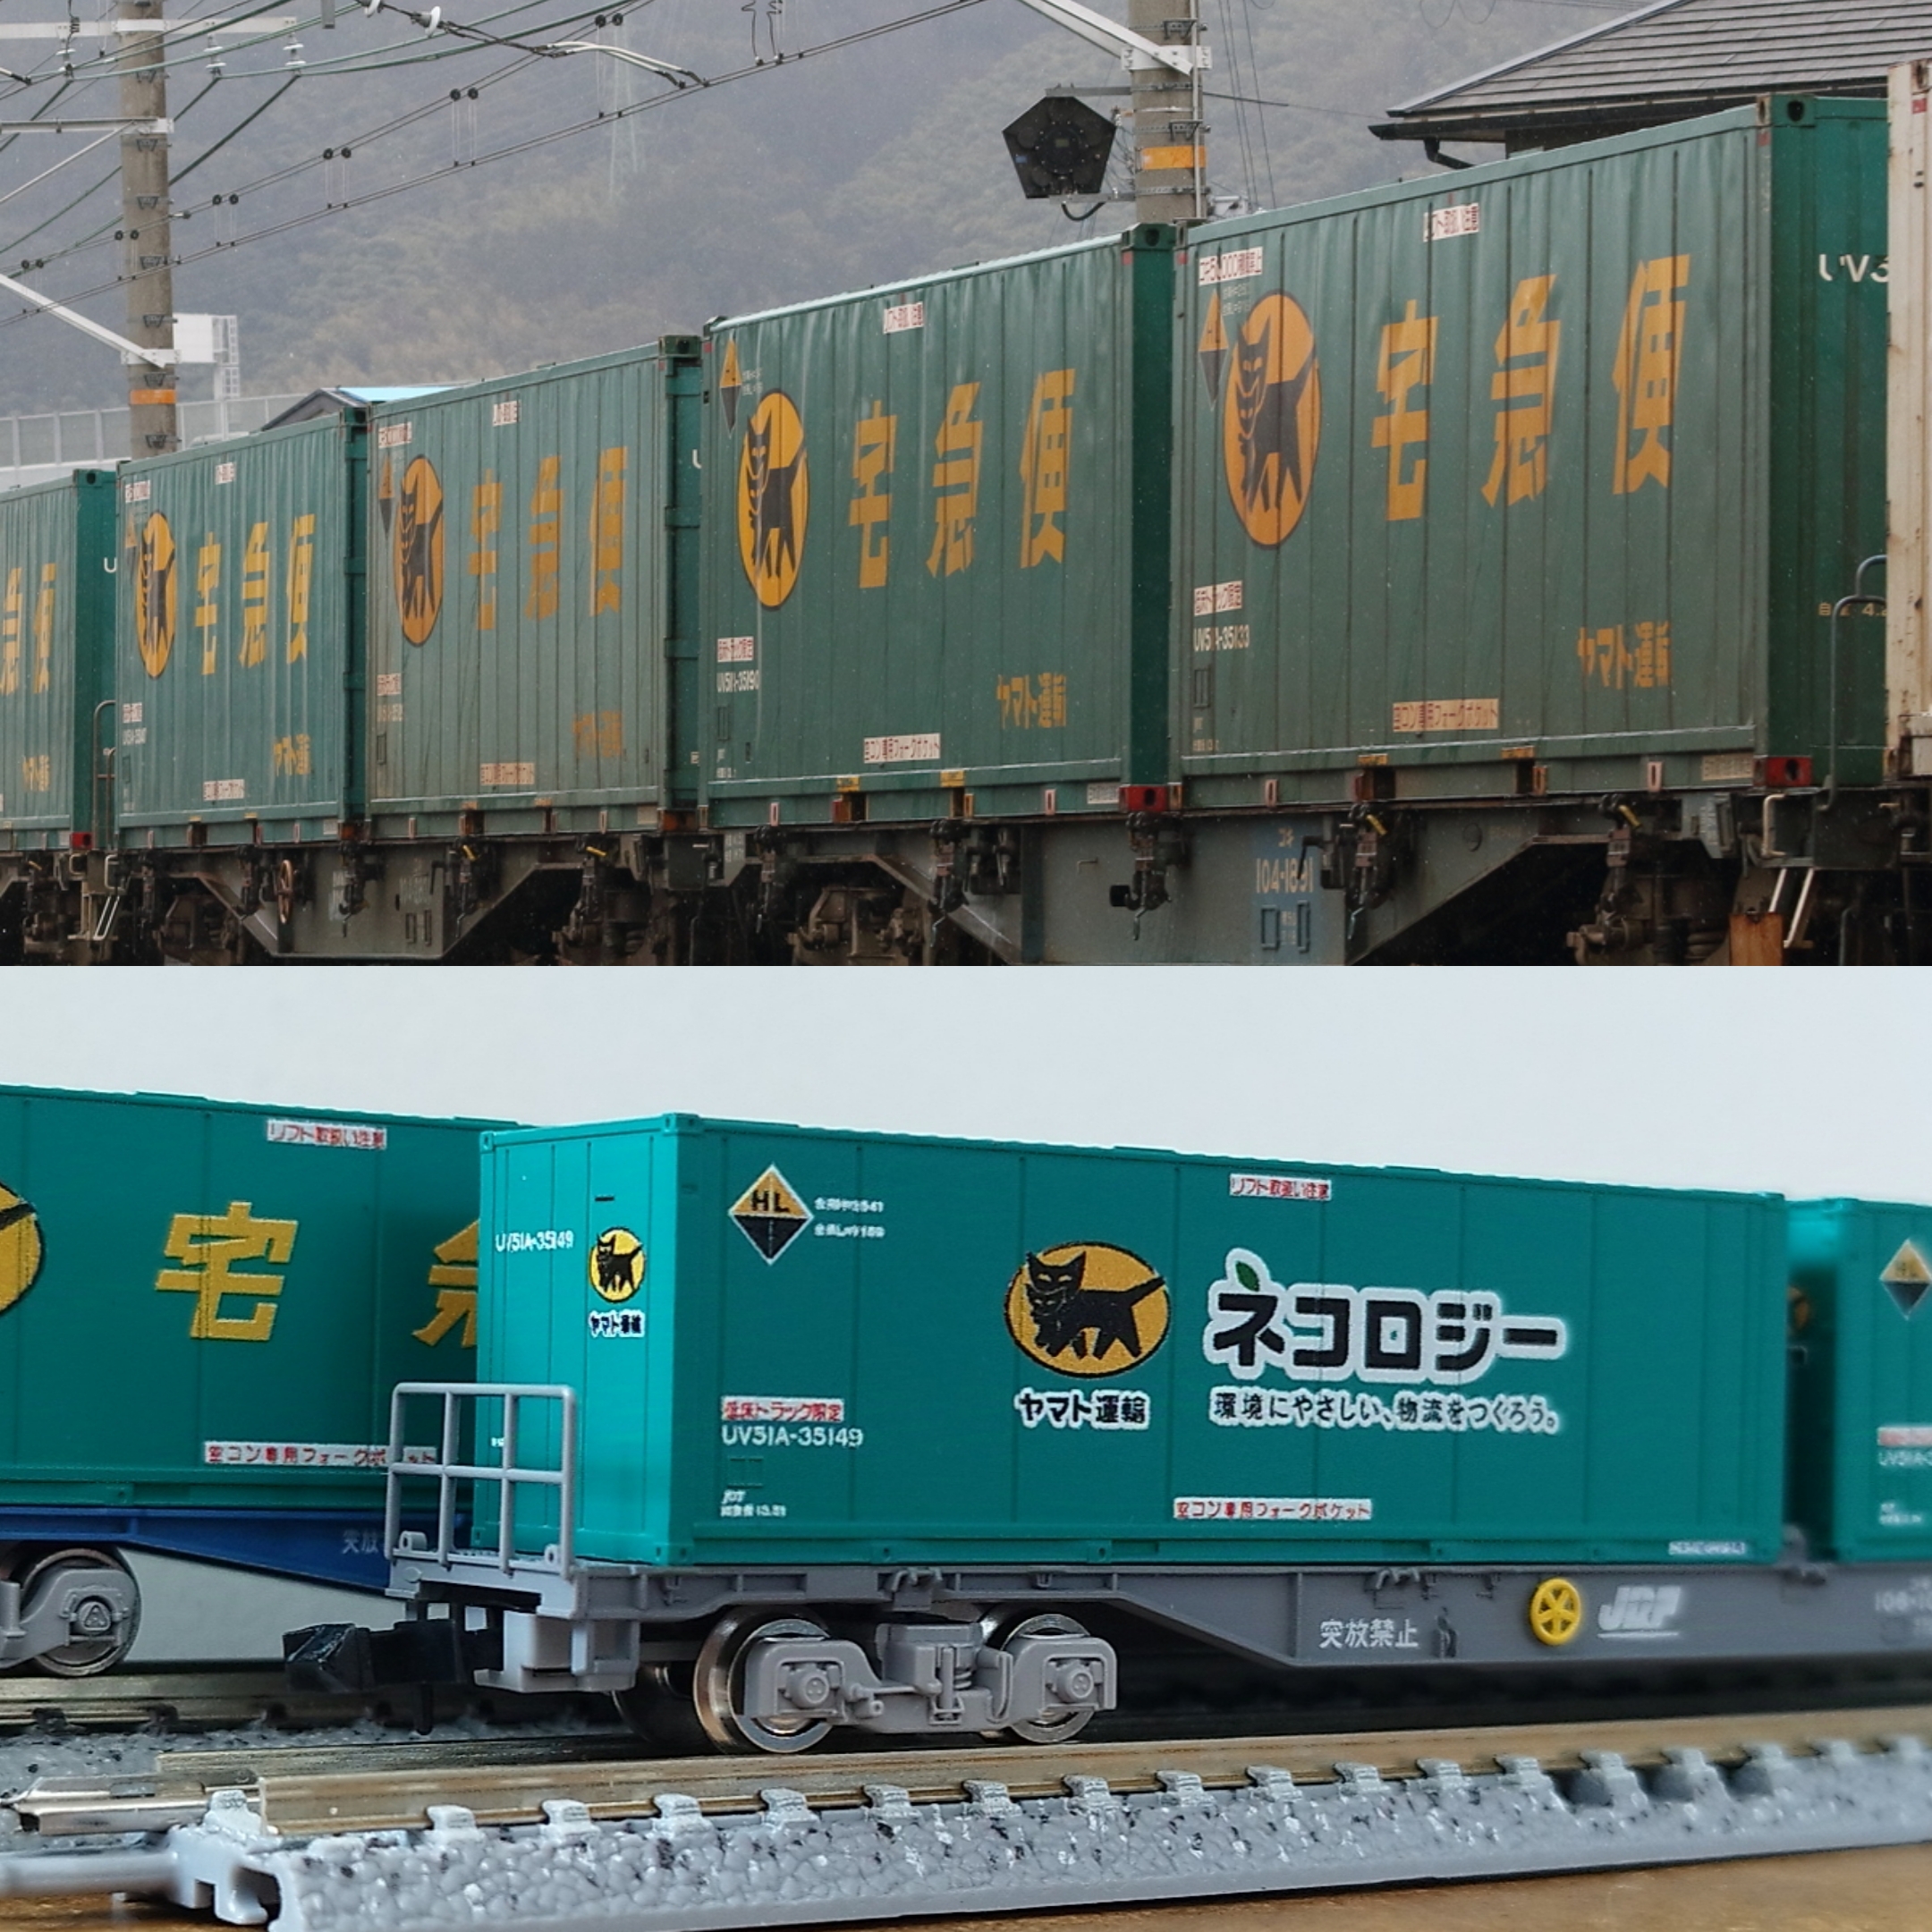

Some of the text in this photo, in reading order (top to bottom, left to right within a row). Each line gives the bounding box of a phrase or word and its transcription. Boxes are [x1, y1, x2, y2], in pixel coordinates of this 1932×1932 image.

[1371, 254, 1690, 521] 宅急便
[849, 369, 1075, 589] 宅急便
[751, 1190, 790, 1213] HL
[1208, 1259, 1562, 1377] ネコロジー
[1018, 1390, 1148, 1428] ヤマト運輸
[722, 1426, 863, 1448] UV51A-35149
[1318, 1617, 1419, 1650] 突放禁止
